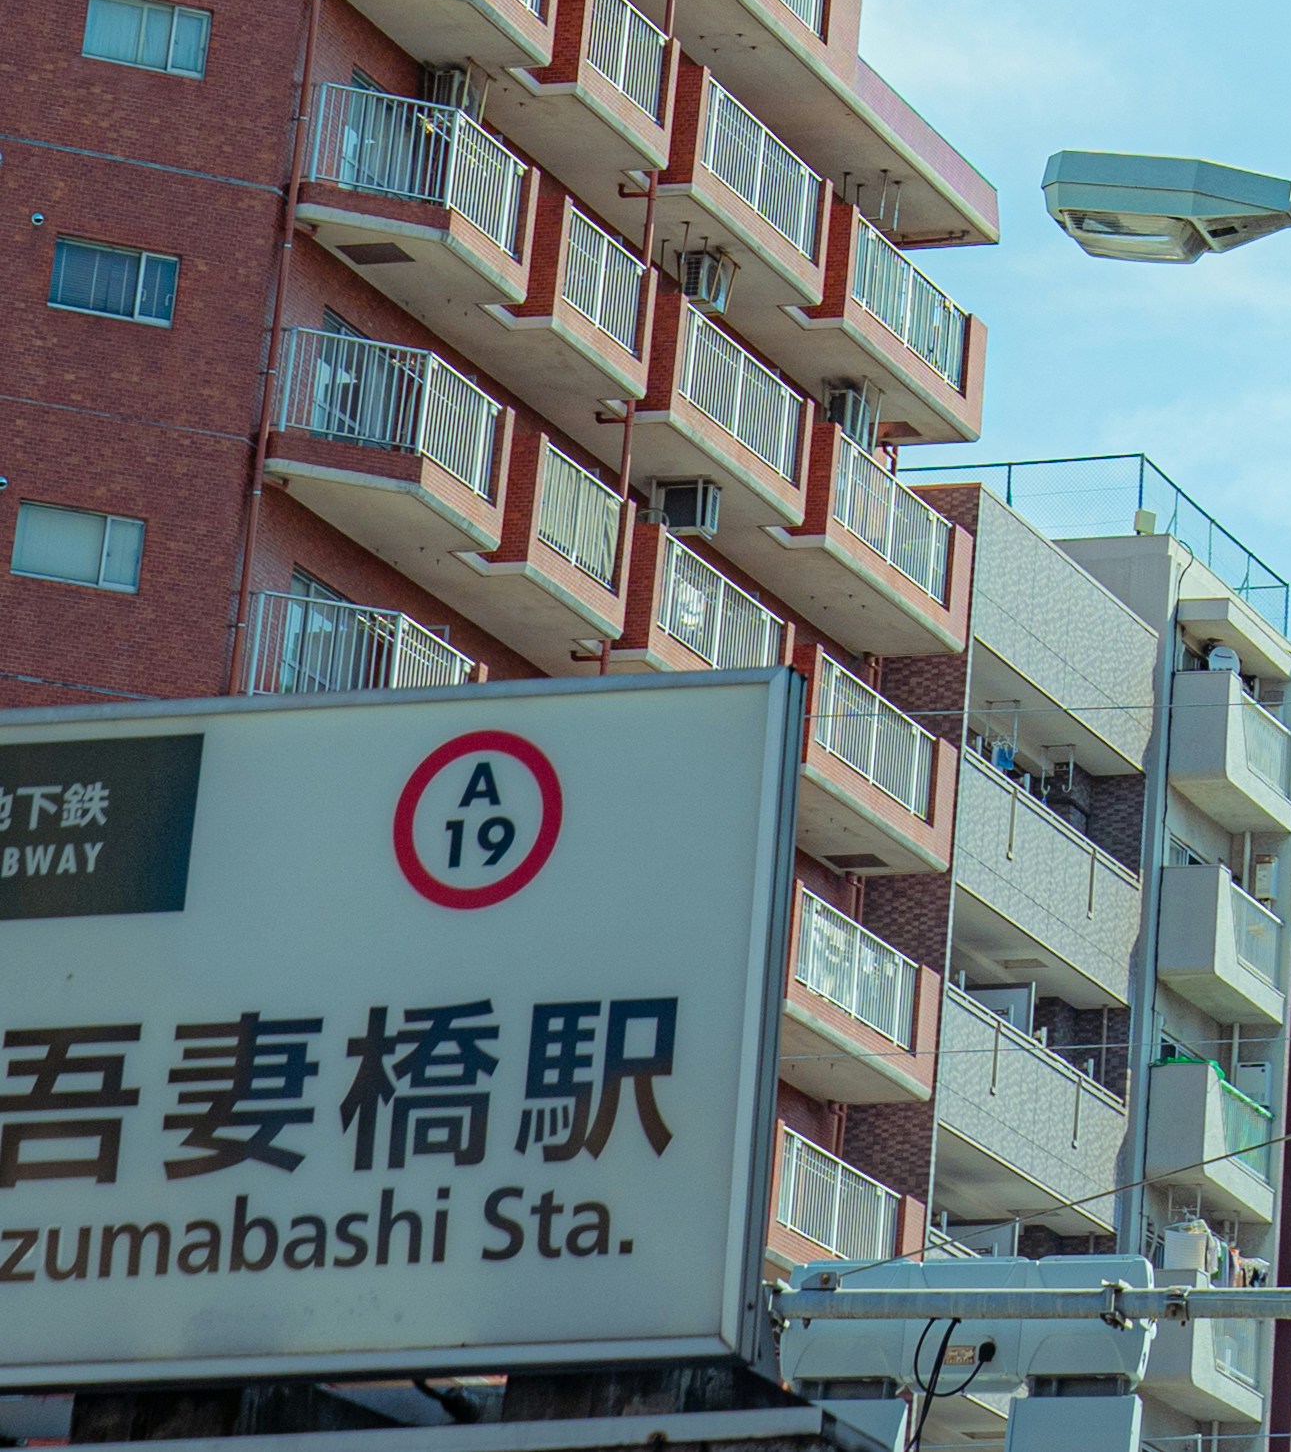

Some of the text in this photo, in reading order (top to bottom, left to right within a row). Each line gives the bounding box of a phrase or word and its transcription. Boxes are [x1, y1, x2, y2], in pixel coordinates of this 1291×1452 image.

[0, 781, 110, 831] 下鉄
[458, 761, 501, 808] A
[445, 815, 516, 869] 19
[0, 997, 679, 1188] 吾妻橋駅
[481, 1186, 634, 1261] Sta.
